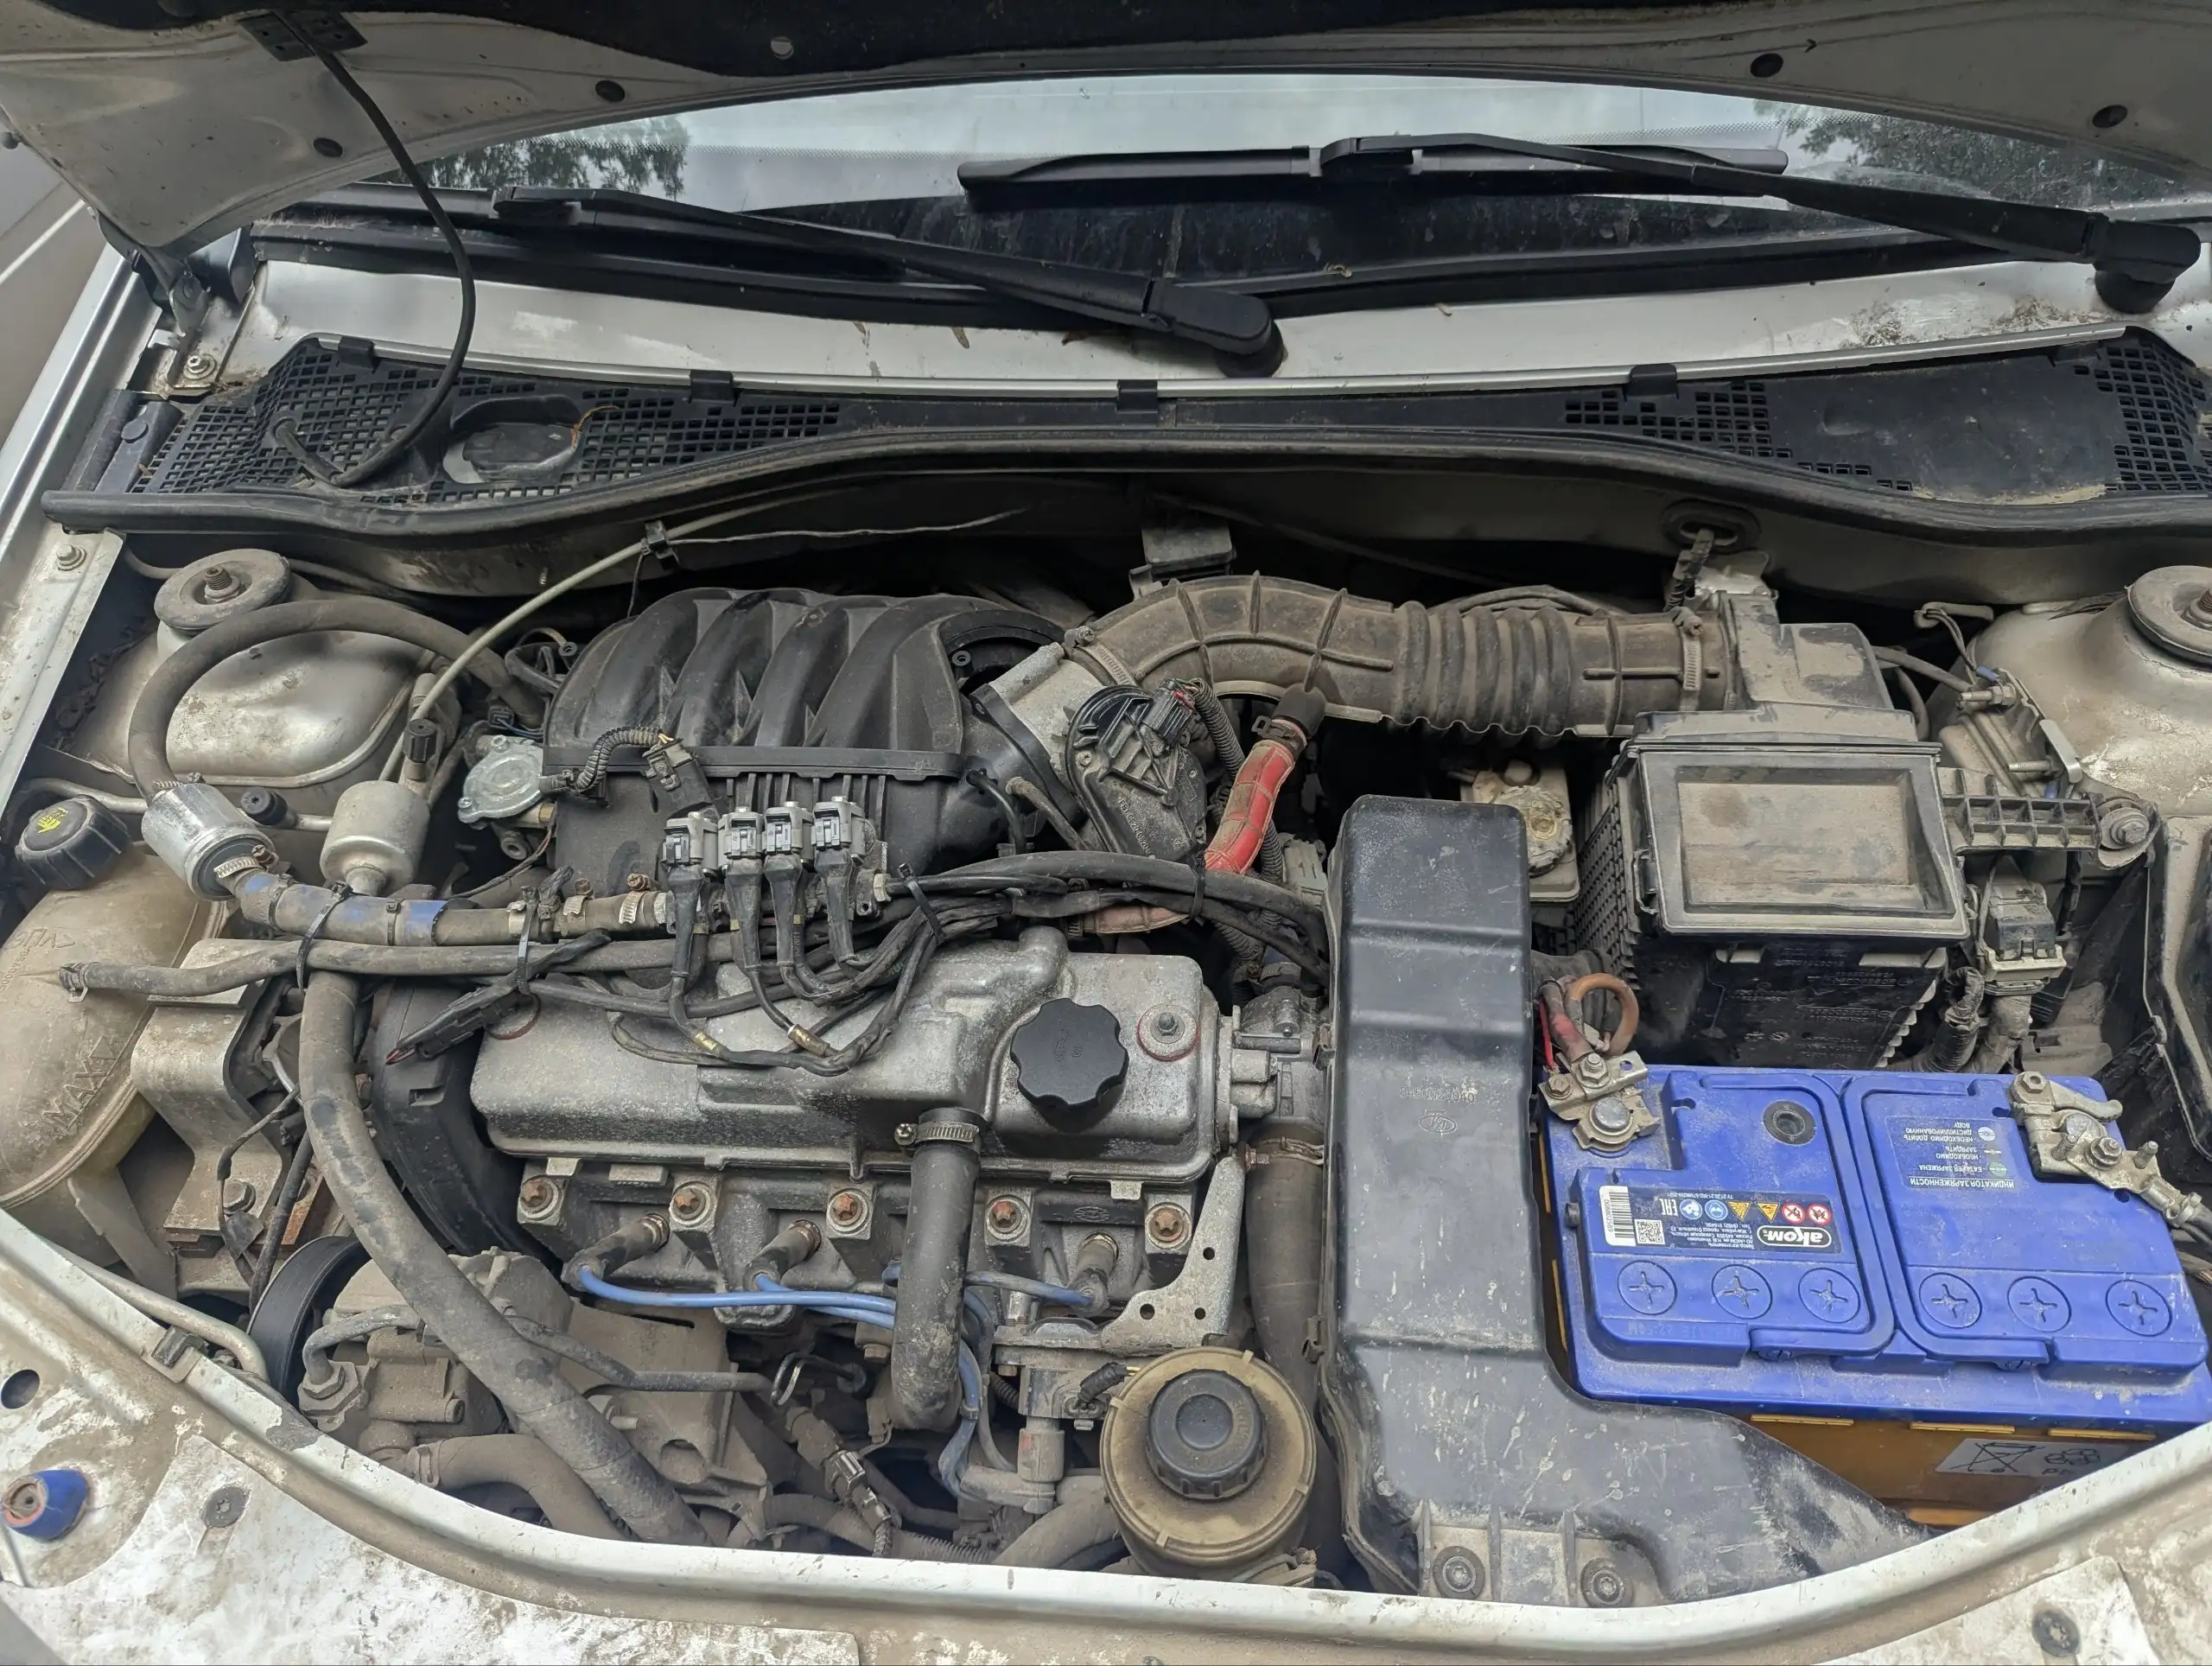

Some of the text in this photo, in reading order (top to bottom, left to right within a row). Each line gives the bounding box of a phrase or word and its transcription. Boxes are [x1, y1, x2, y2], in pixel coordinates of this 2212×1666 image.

[1905, 1127, 1973, 1135] ДИСТИЛЛИРОВАННУЮ
[1910, 1178, 2014, 1188] ИНДИКАТОР ЗАРЯЖЕННОСТИ
